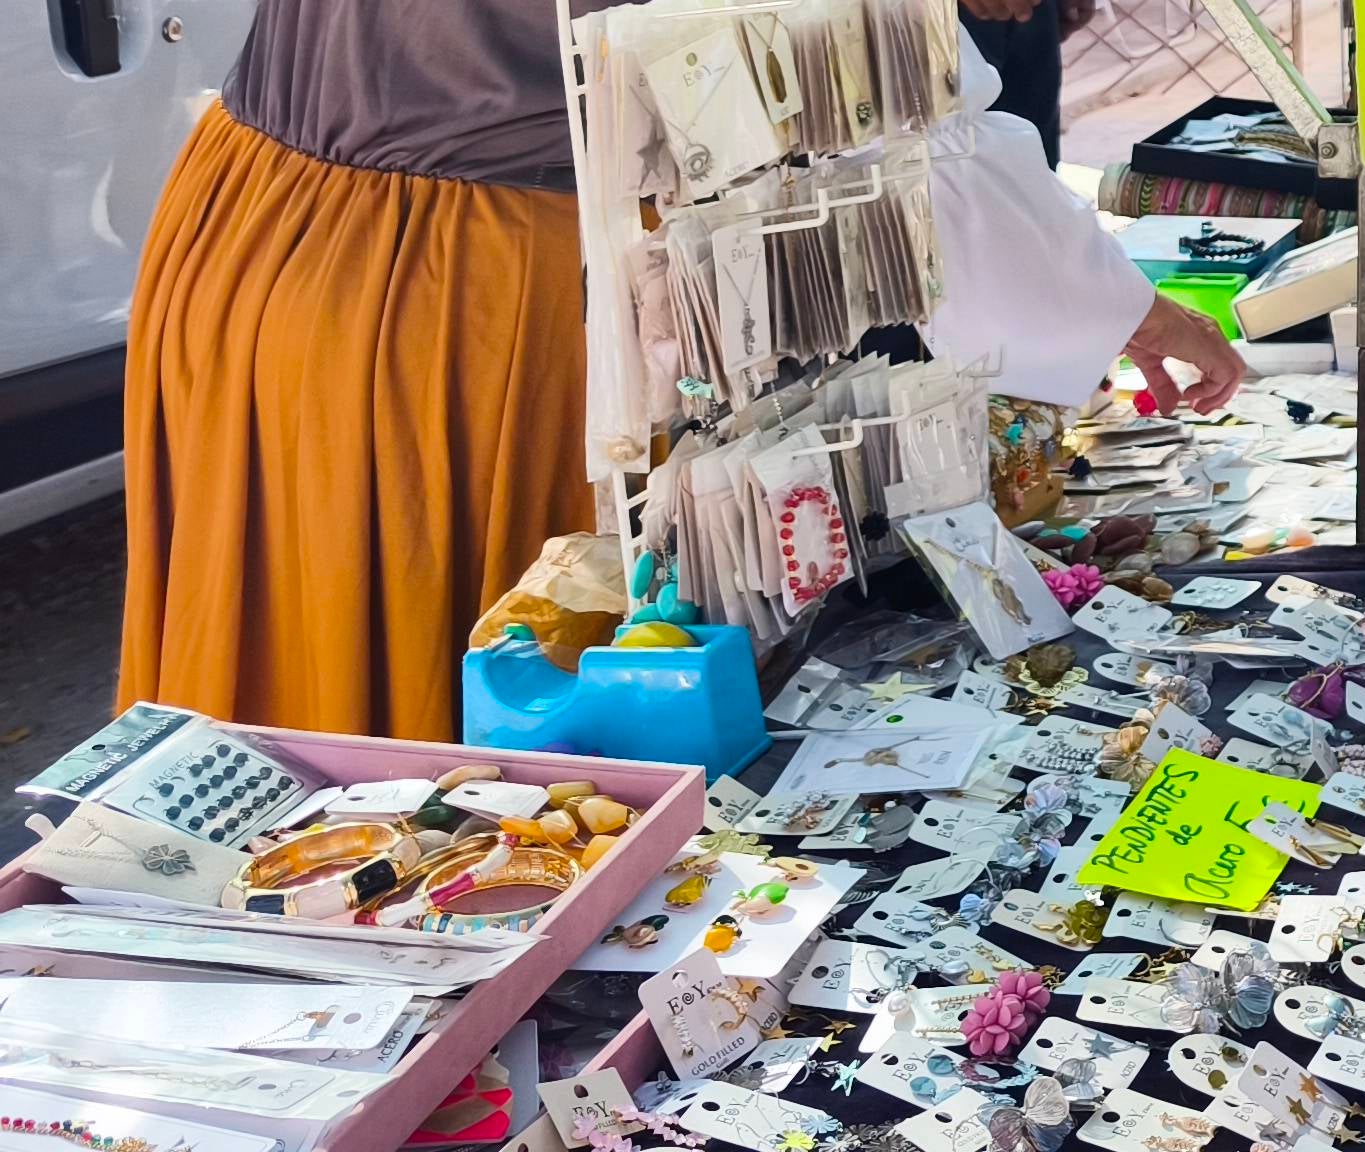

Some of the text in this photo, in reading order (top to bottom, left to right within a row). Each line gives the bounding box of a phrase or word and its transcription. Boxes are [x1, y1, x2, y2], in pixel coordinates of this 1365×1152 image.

[65, 751, 128, 793] MAGNETIC
[1092, 763, 1200, 874] PENDIENTES
[1166, 822, 1203, 846] de
[377, 1030, 404, 1064] ACERO
[692, 1055, 718, 1077] GOLD
[717, 1036, 746, 1060] FILLED
